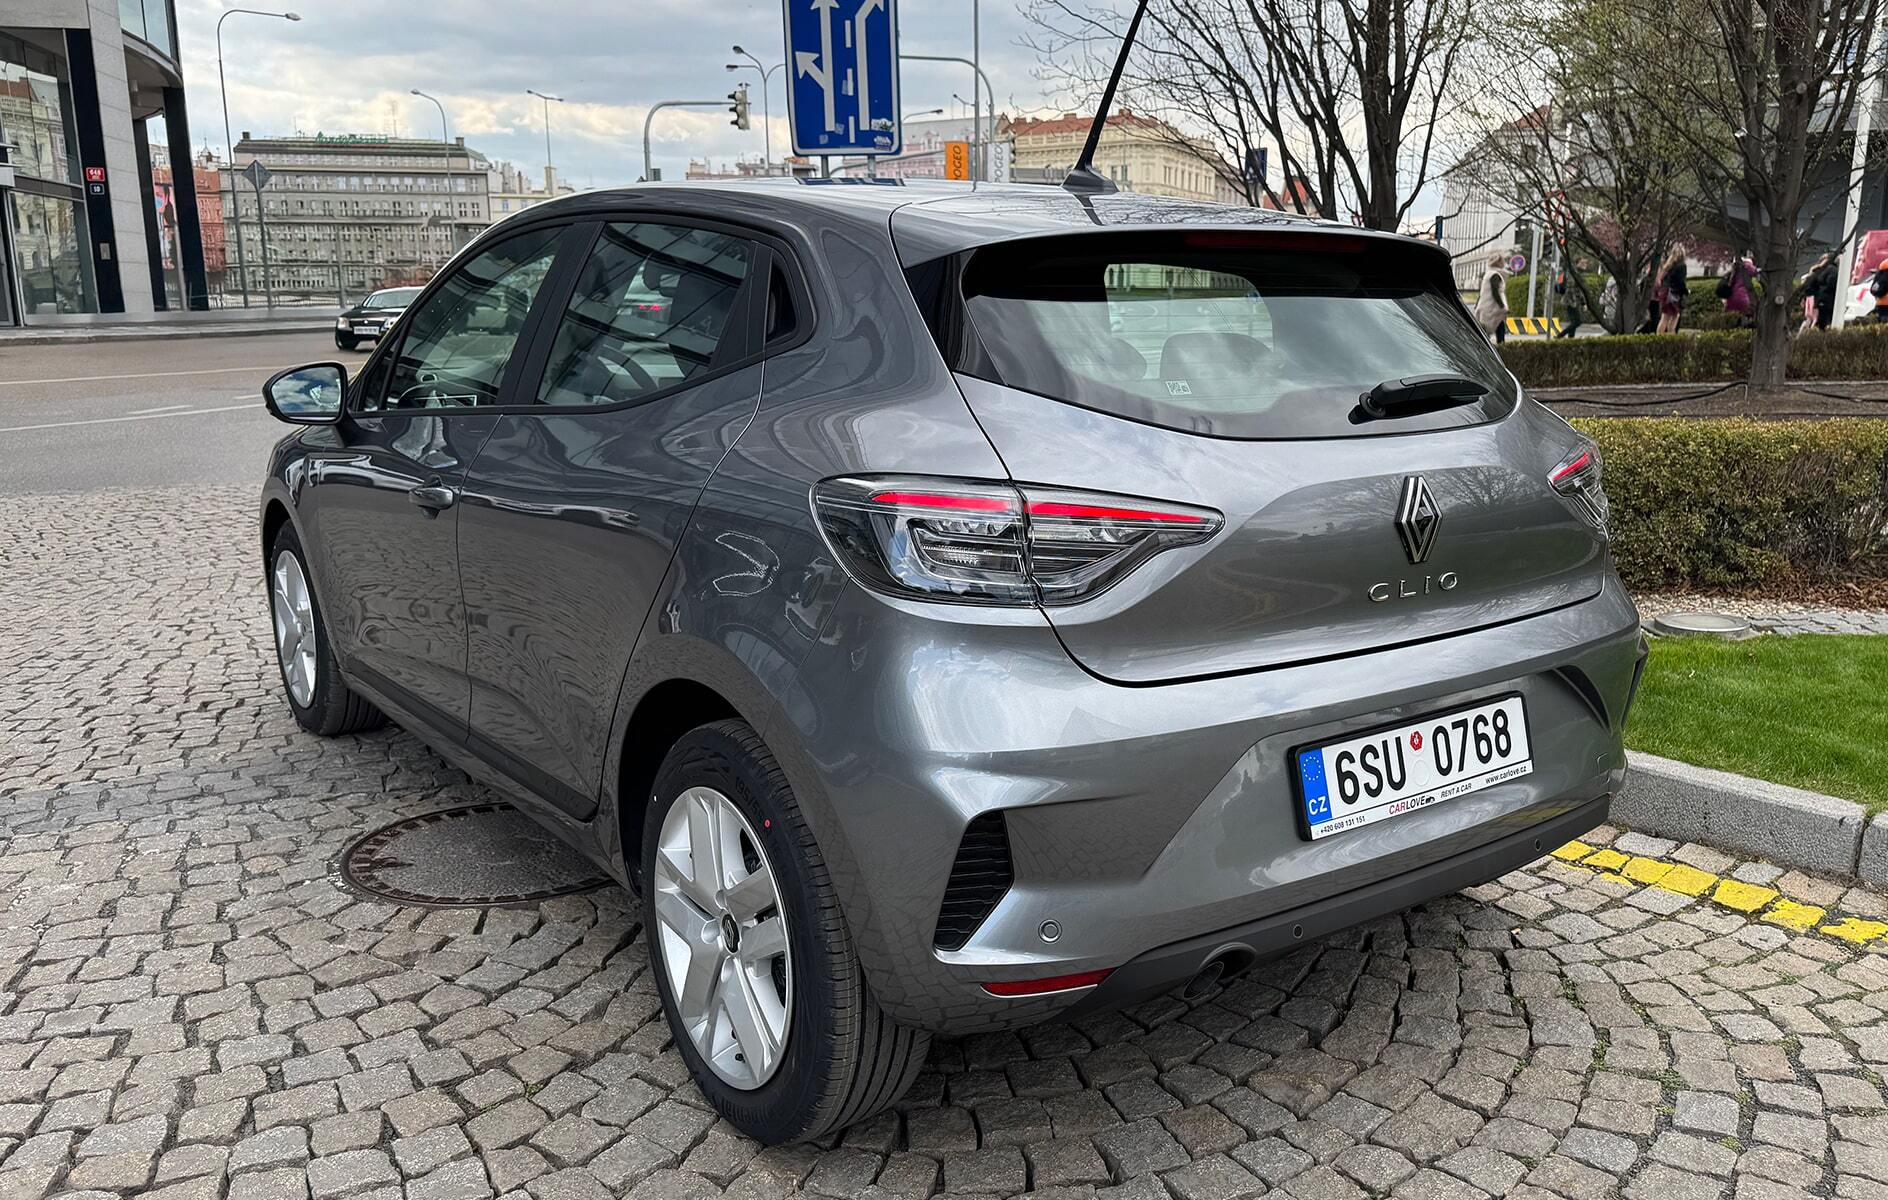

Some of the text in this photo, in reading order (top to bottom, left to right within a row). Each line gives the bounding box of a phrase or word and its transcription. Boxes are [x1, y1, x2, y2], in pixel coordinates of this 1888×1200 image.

[953, 145, 962, 180] OGEO
[1368, 571, 1457, 601] CLIO
[1335, 708, 1512, 805] 6SU 0768
[1485, 765, 1527, 784] www.carlove.cz
[1441, 787, 1456, 798] RENT
[1461, 783, 1472, 792] CAR
[1309, 796, 1328, 815] CZ
[1389, 796, 1426, 815] CARLOVE
